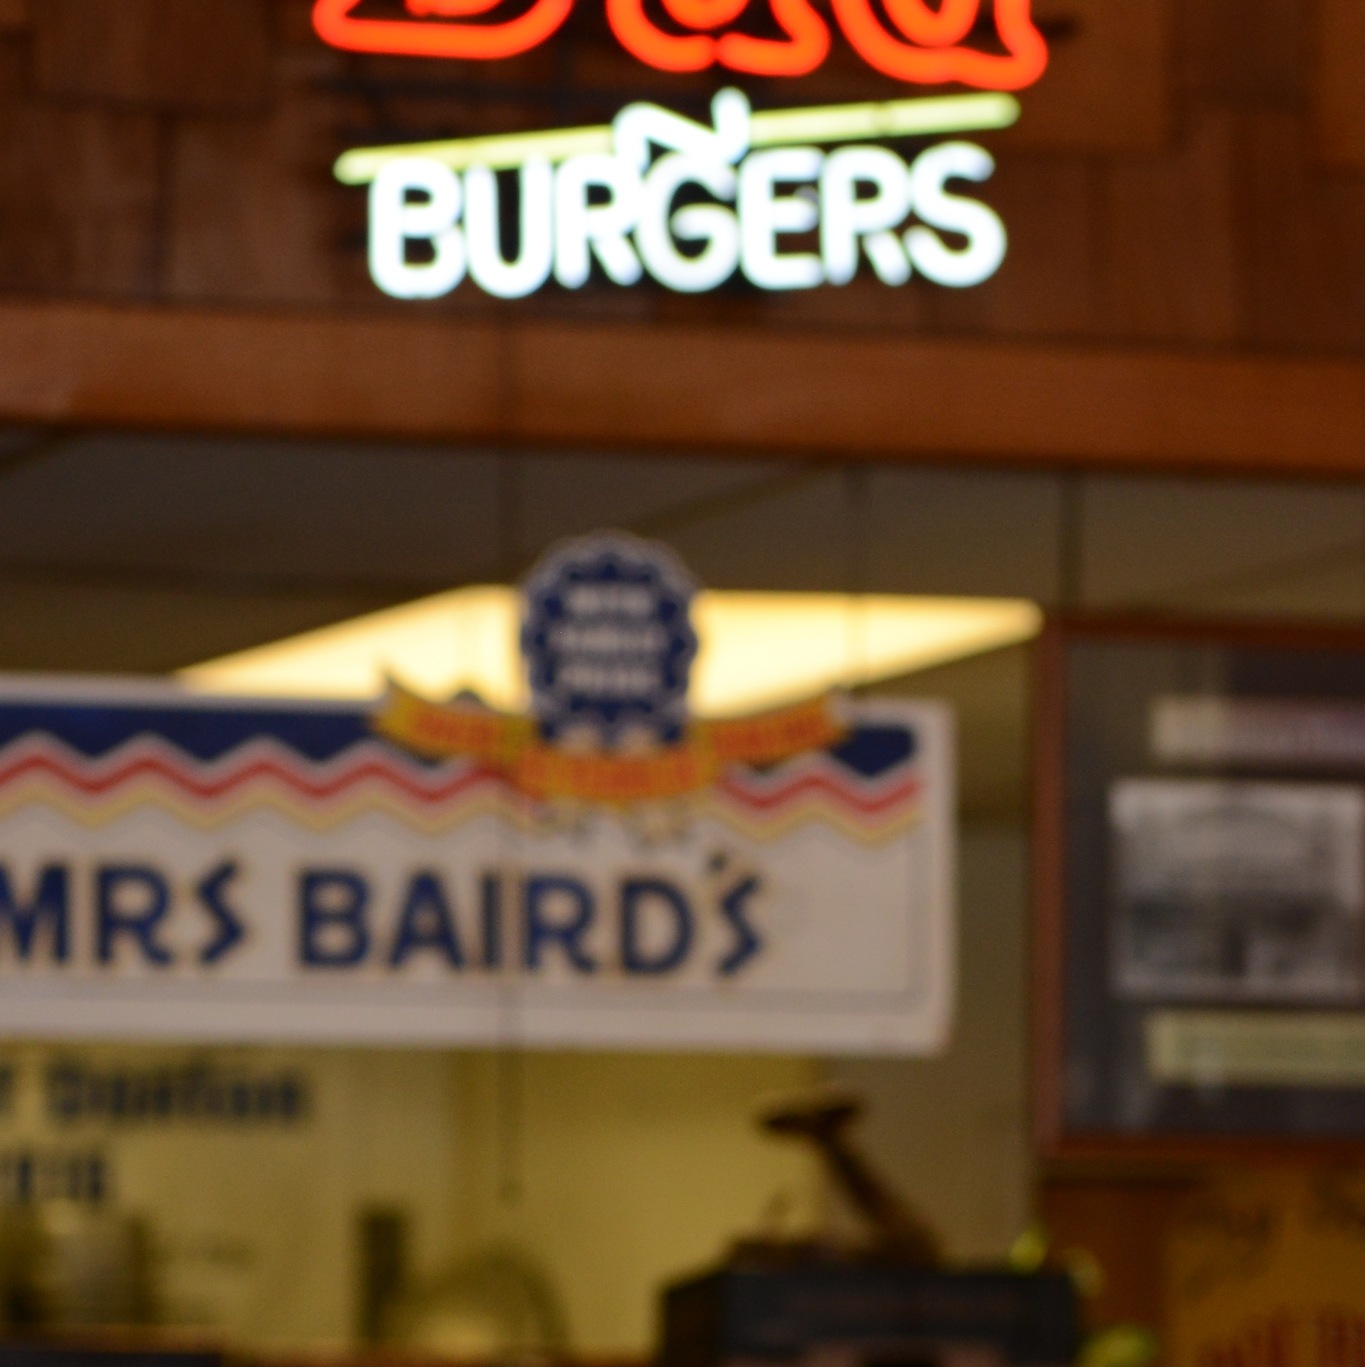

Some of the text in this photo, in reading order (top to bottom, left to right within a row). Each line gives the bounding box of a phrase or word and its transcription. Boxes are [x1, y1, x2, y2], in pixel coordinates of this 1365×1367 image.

[368, 140, 1009, 299] BURGERS
[0, 853, 765, 978] MRS BAIRD'S
